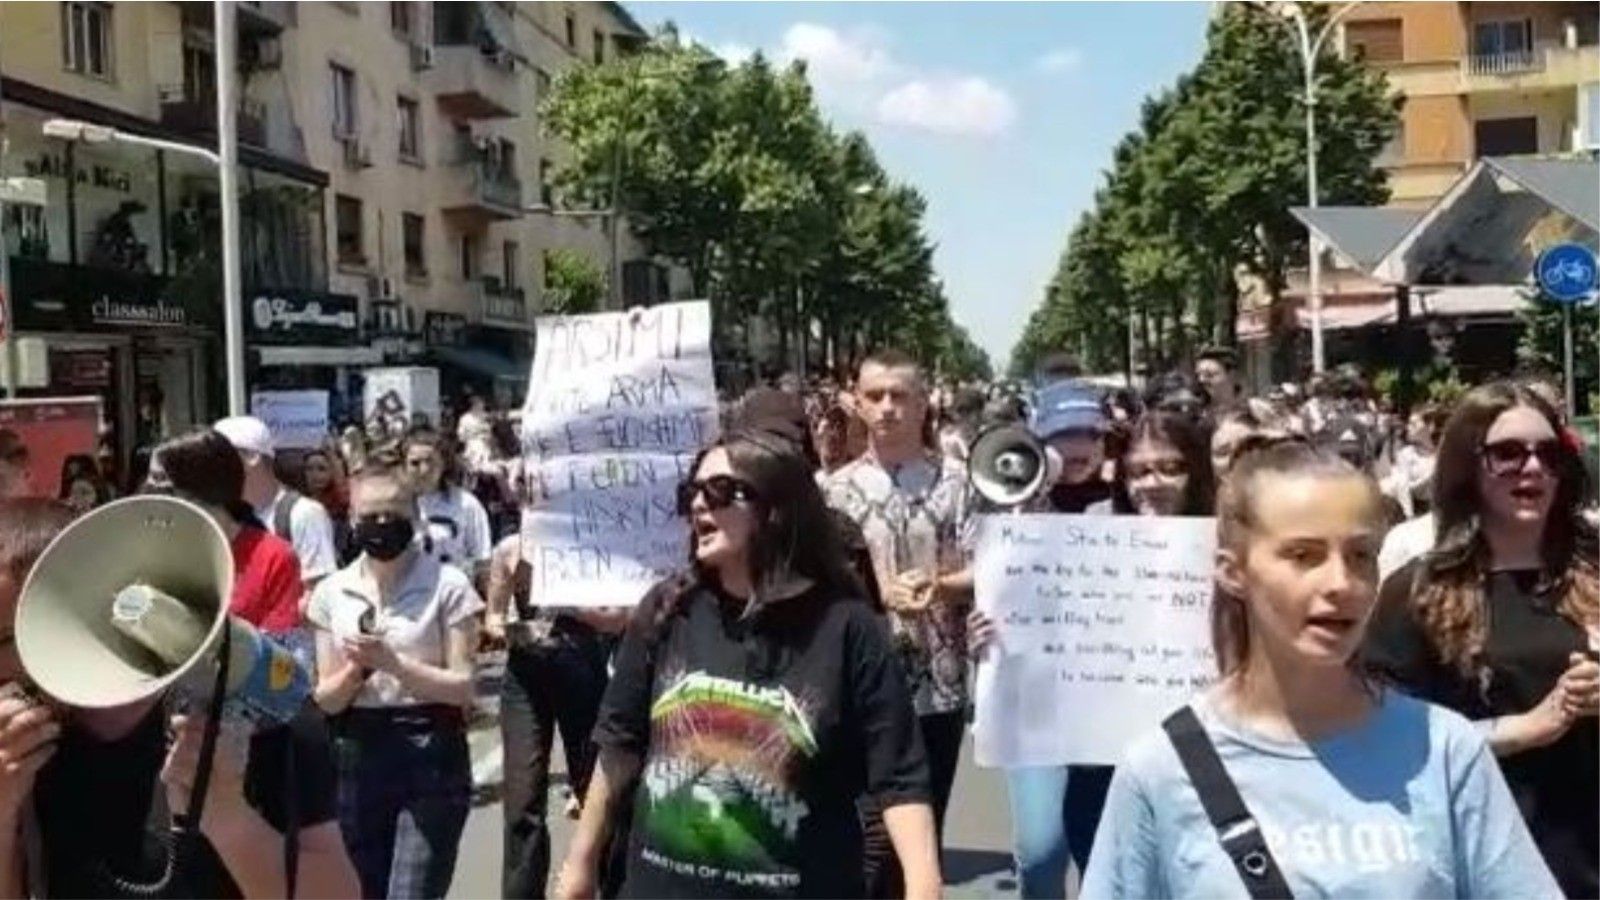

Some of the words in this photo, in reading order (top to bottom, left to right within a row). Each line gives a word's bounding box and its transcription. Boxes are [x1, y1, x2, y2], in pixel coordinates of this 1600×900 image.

[1171, 591, 1208, 609] NOT
[641, 848, 695, 876] MASTER
[698, 865, 720, 878] OF
